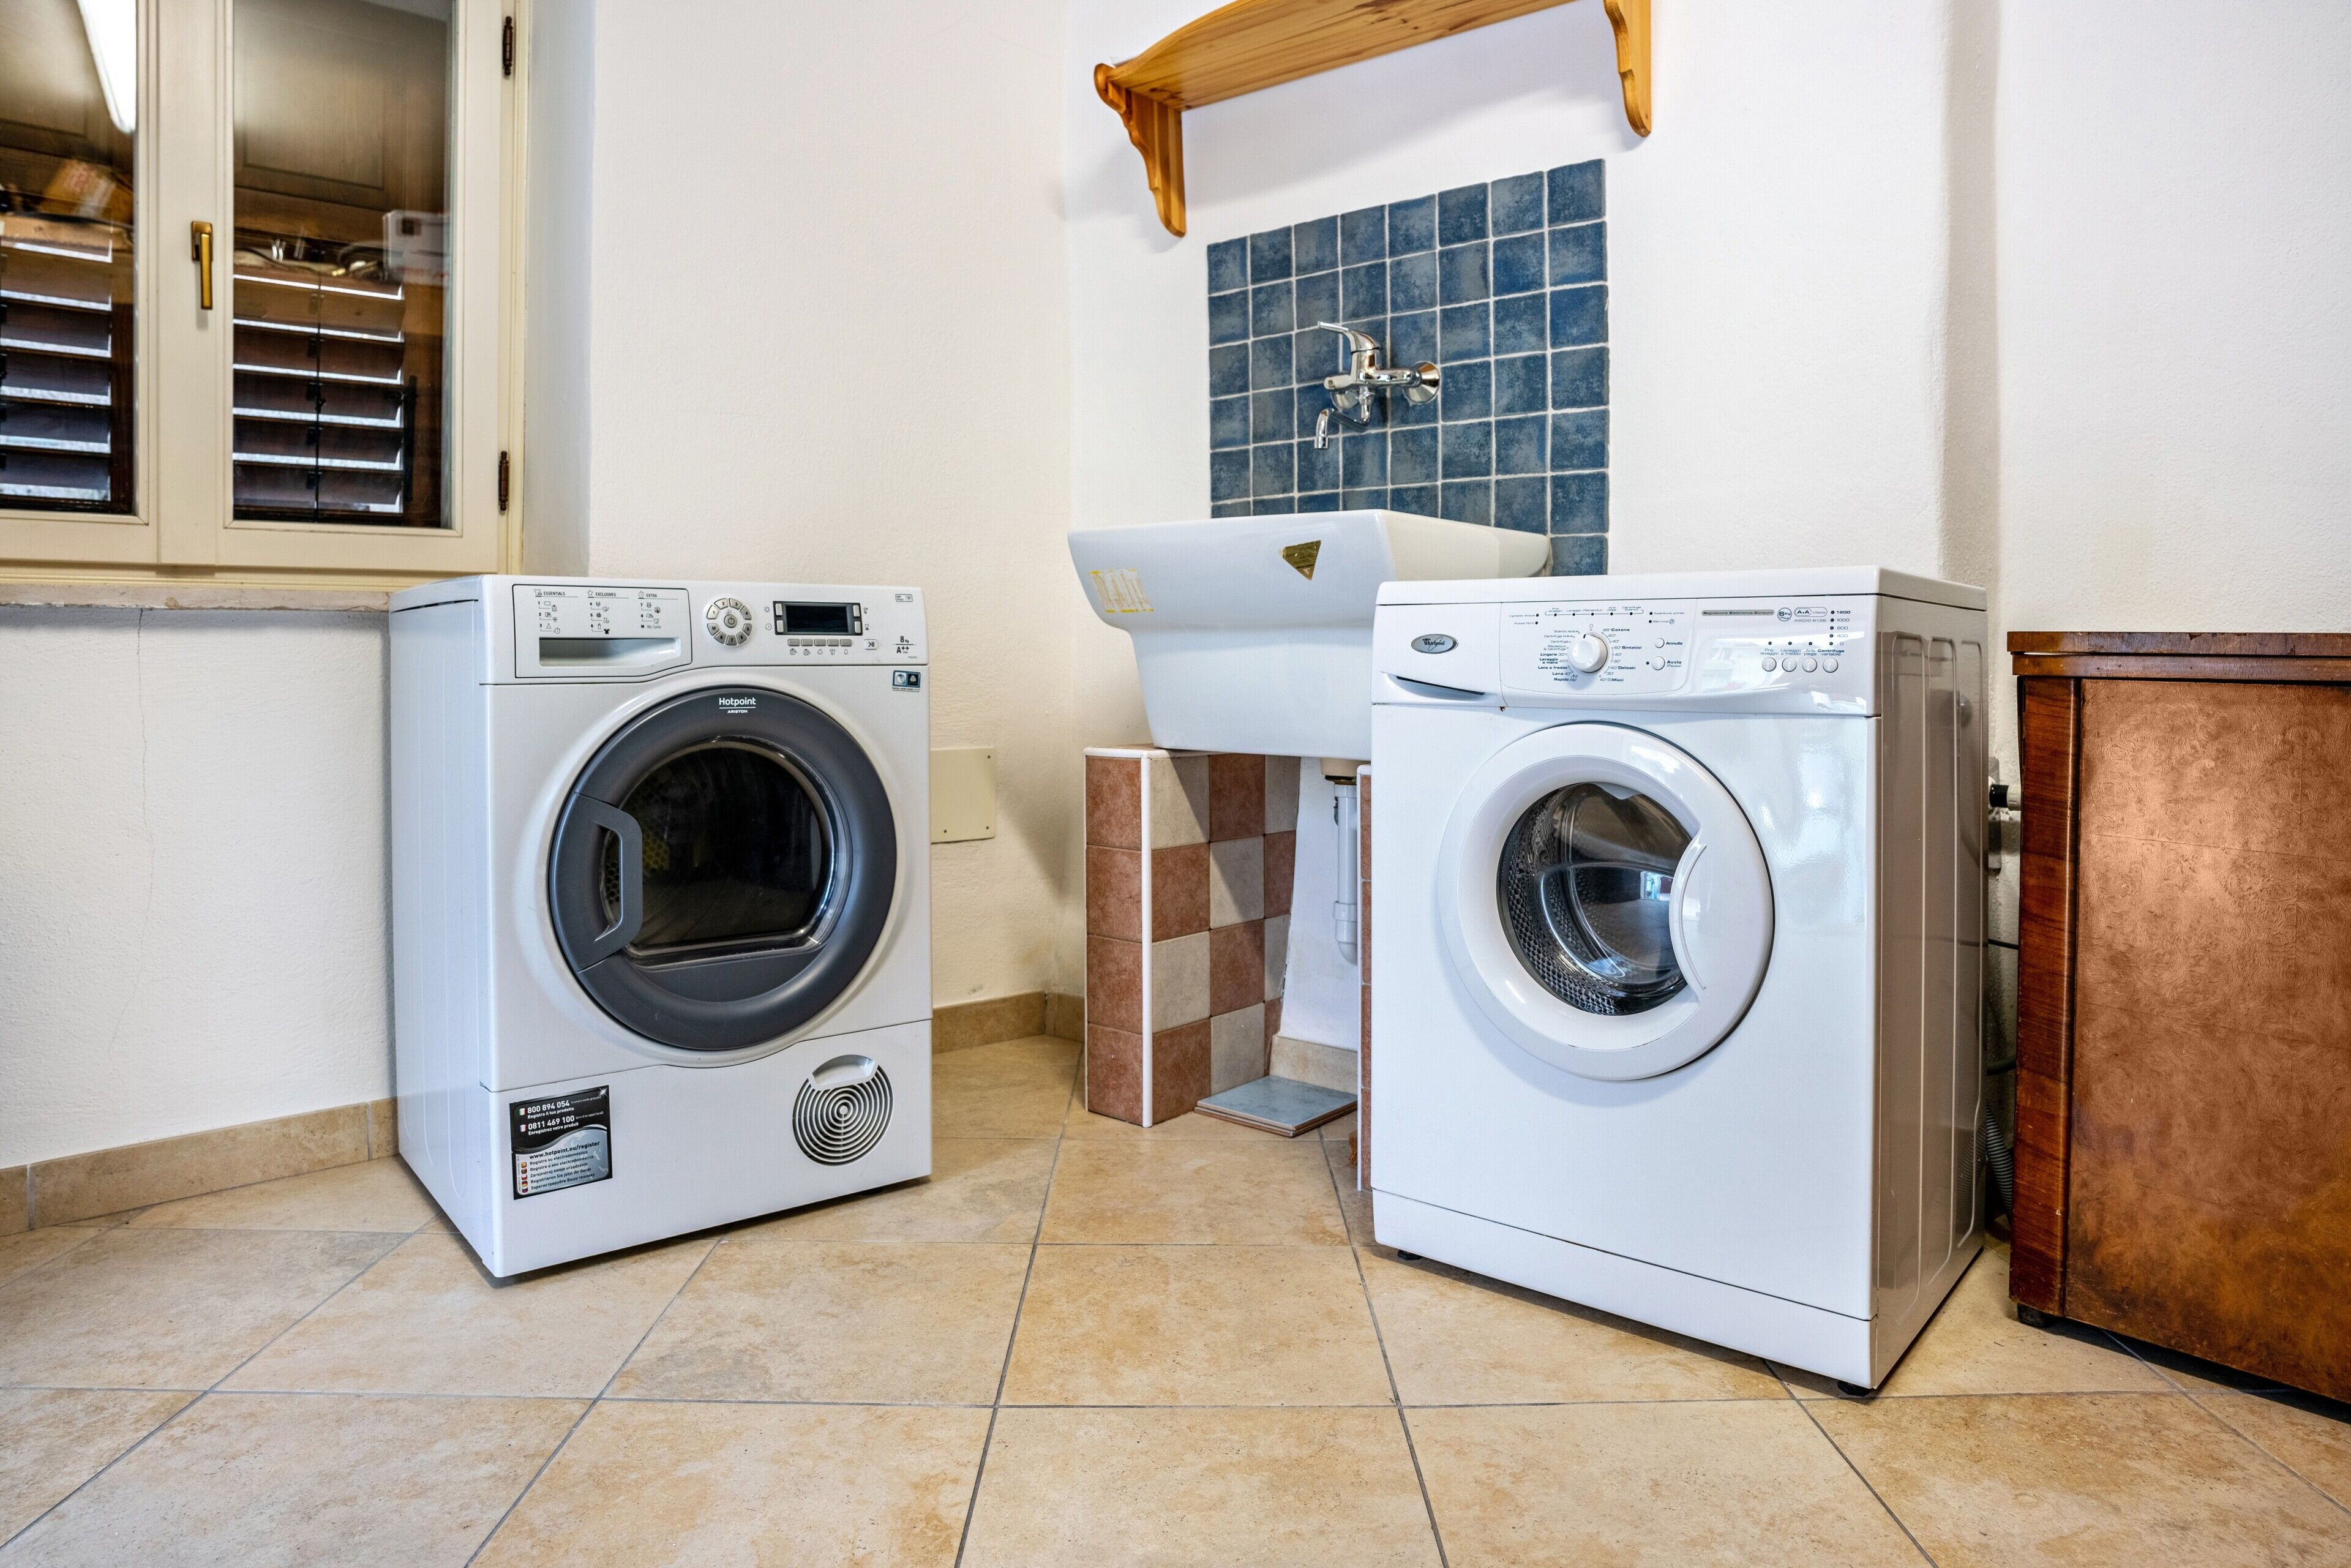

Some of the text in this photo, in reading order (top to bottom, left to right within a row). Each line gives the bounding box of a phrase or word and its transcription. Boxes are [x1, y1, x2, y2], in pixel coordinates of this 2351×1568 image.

[719, 697, 756, 707] Hotpoint
[527, 1105, 541, 1114] 800
[542, 1103, 555, 1111] 894
[528, 1121, 546, 1130] 0811
[562, 1115, 575, 1123] 100
[529, 1141, 600, 1160] www.hotpoint.eu/register
[553, 1150, 588, 1161] electrodoméstico
[560, 1155, 594, 1165] electrodoméstico
[566, 1162, 588, 1171] urządzenie
[530, 1176, 556, 1184] Registrieren
[531, 1179, 566, 1190] Зарегистрируйте
